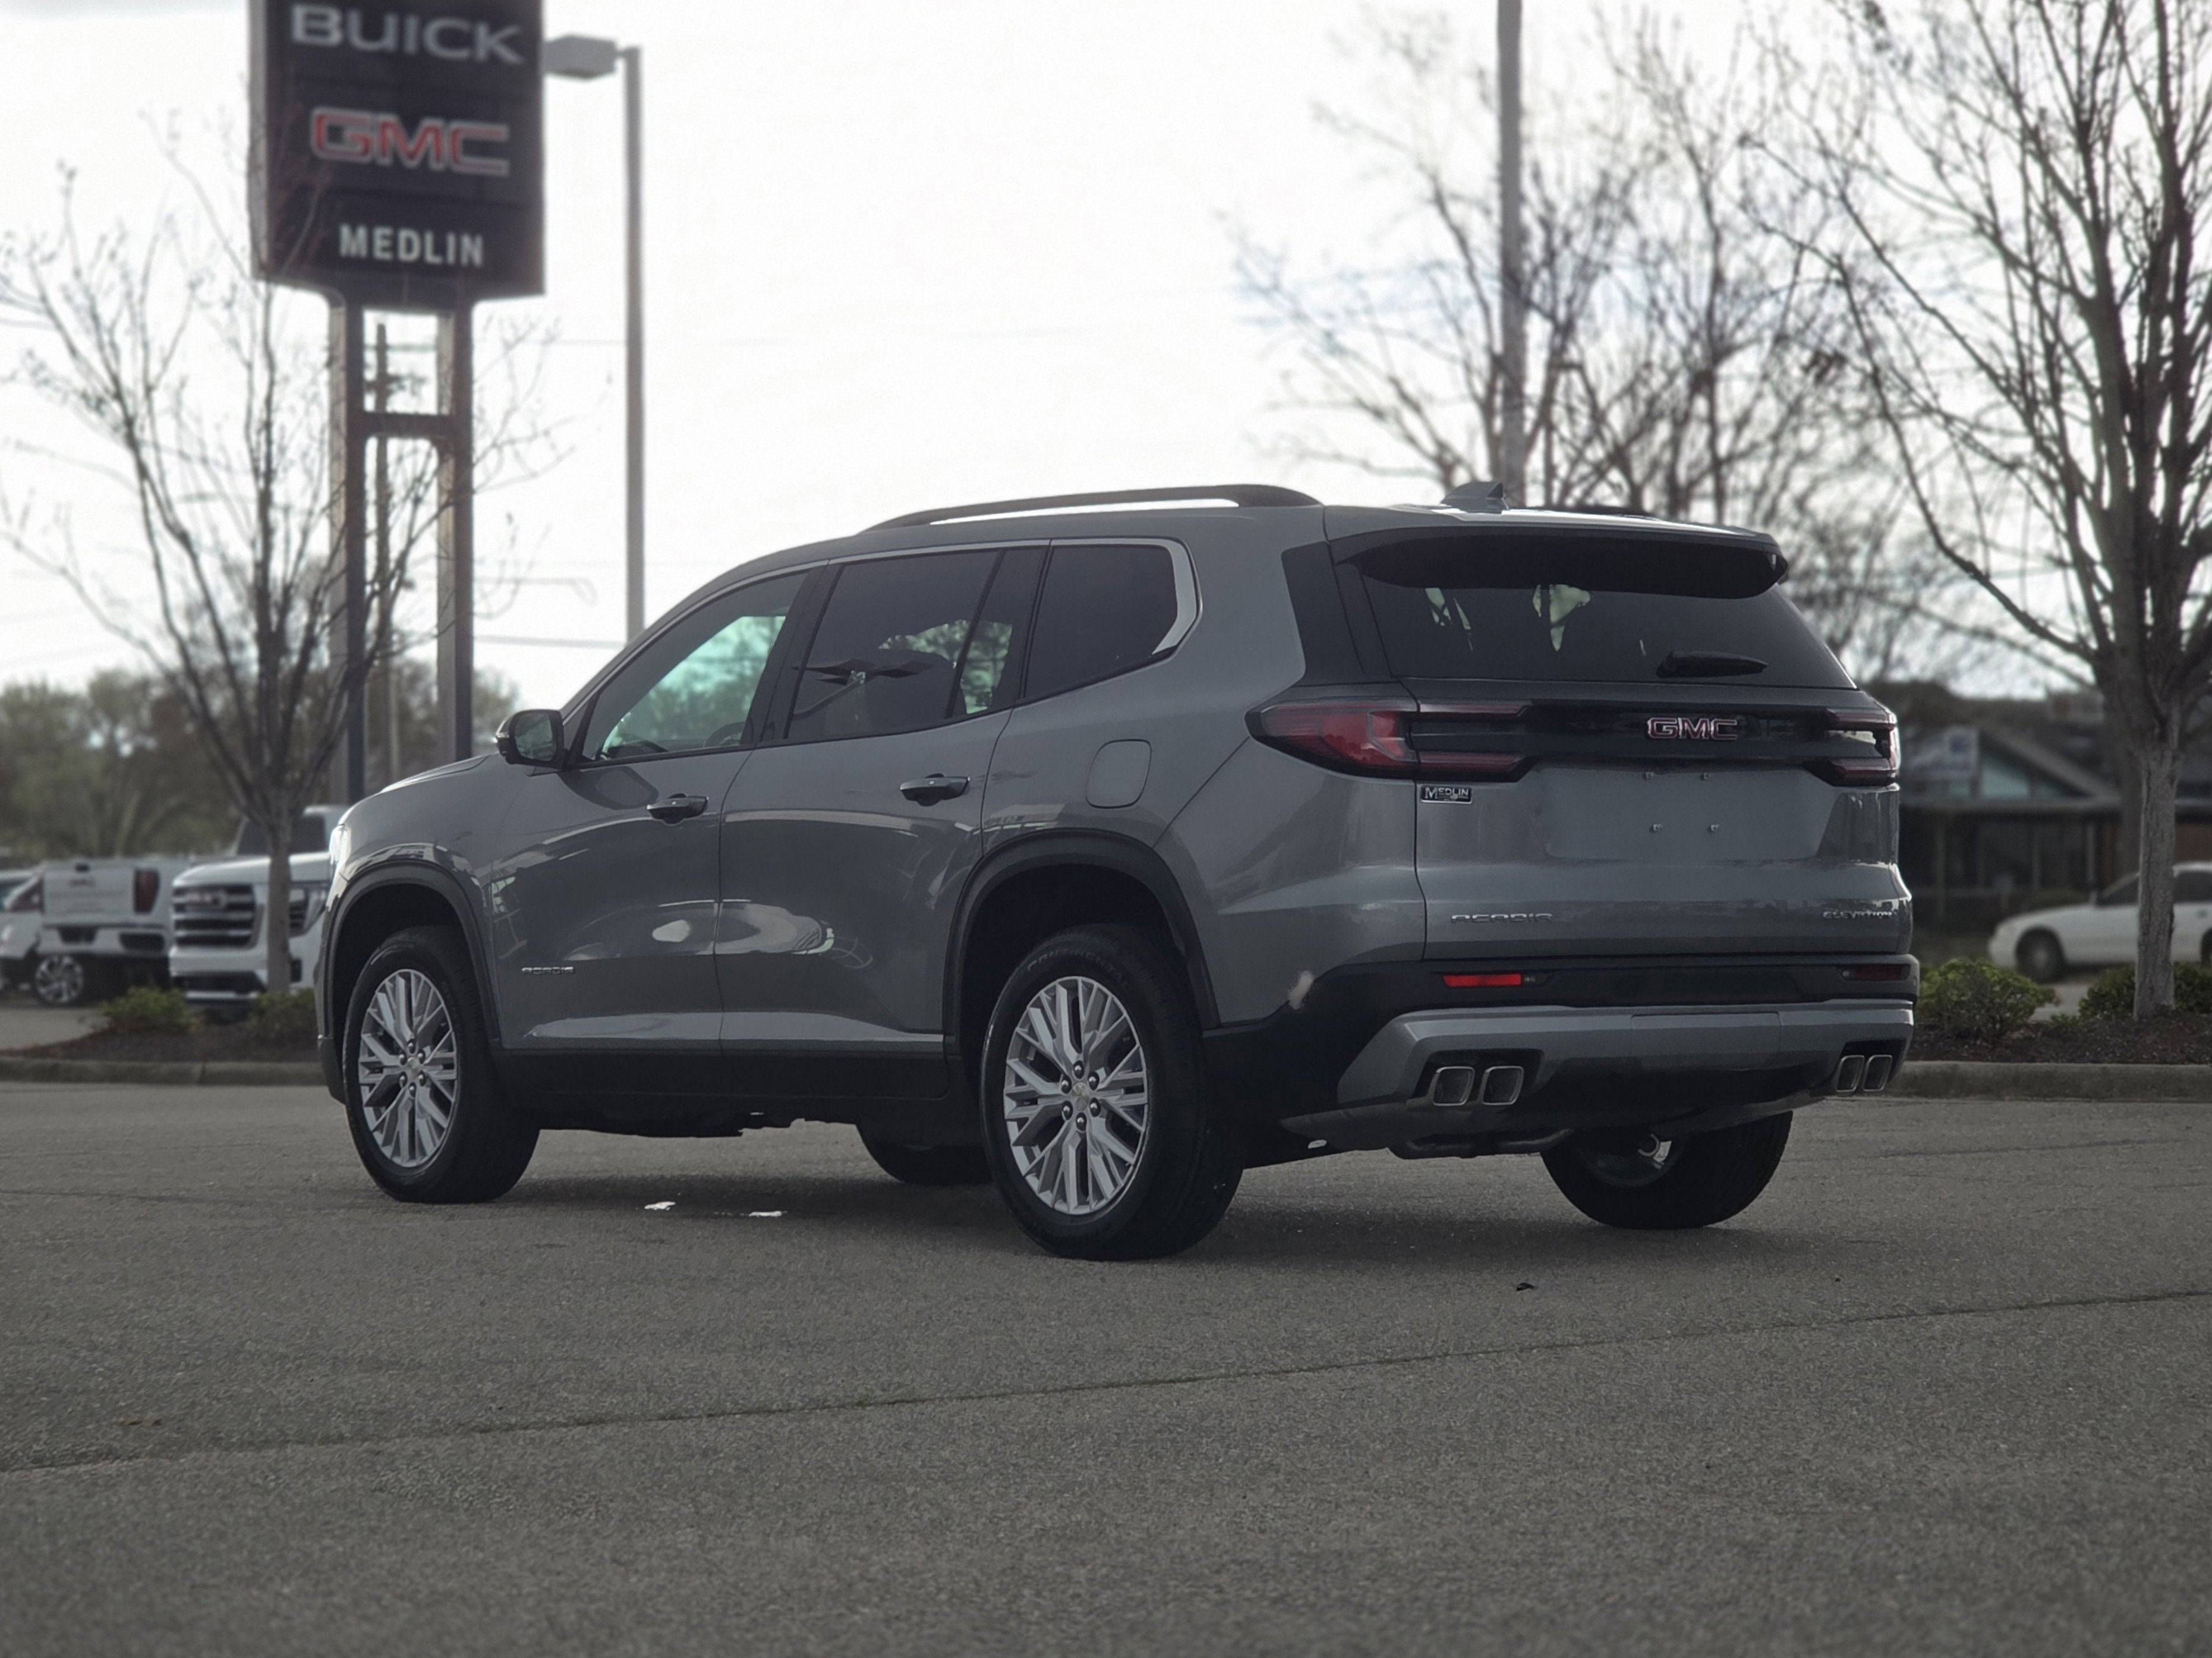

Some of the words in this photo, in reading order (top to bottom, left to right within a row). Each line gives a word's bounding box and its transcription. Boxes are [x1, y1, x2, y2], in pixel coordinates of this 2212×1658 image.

[291, 4, 525, 65] BUICK
[310, 106, 511, 178] GMC
[339, 222, 484, 267] MEDLIN
[1647, 717, 1738, 740] GMC
[1425, 787, 1469, 799] MEDLIN
